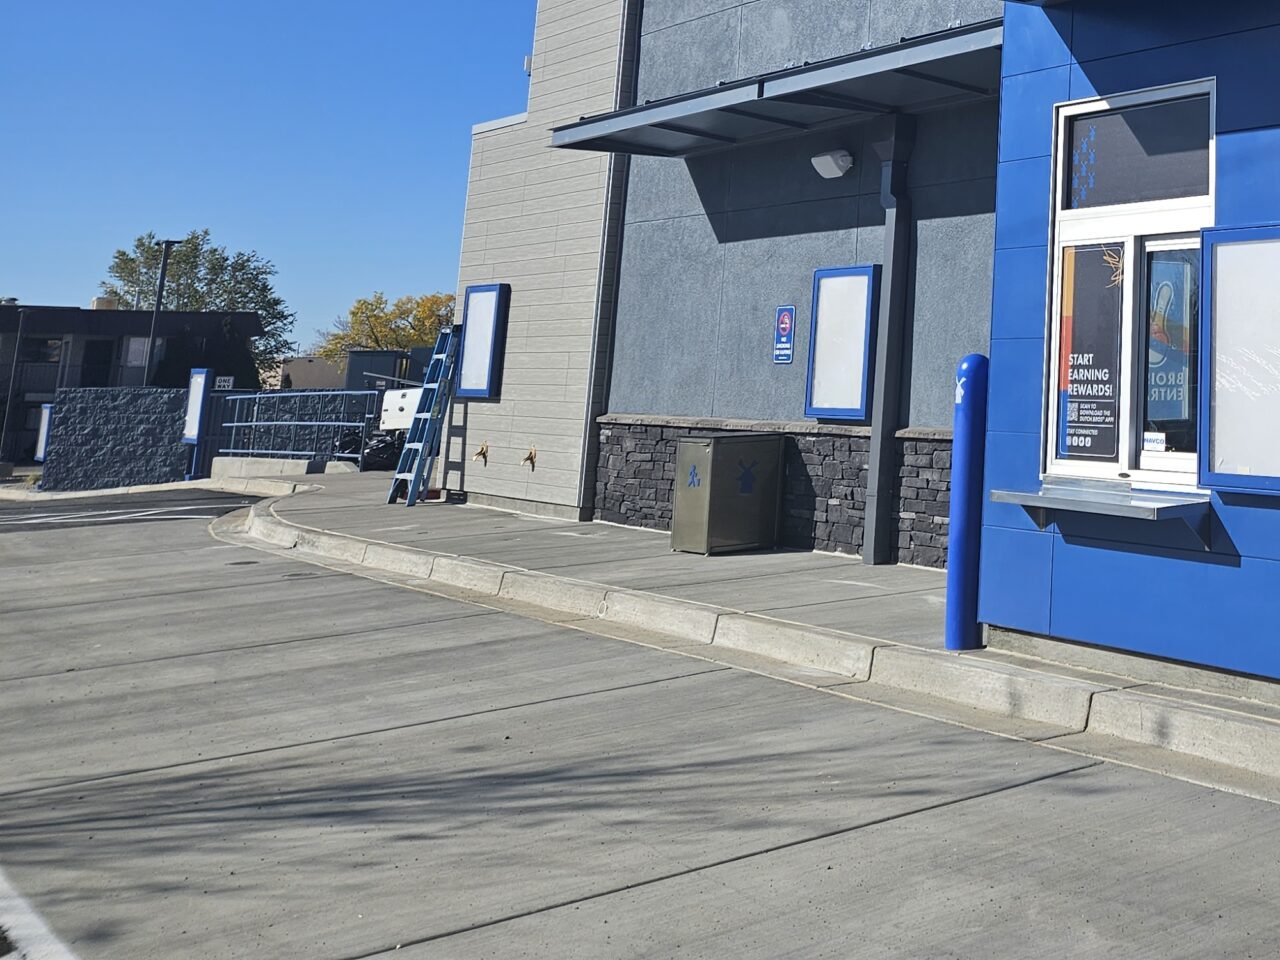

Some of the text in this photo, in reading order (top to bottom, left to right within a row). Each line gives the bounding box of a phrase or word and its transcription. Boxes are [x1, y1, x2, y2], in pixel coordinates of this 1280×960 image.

[1069, 354, 1094, 365] START
[1068, 369, 1110, 381] EARNING
[1067, 384, 1113, 396] REWARDS!
[1144, 437, 1165, 445] NAVCO
